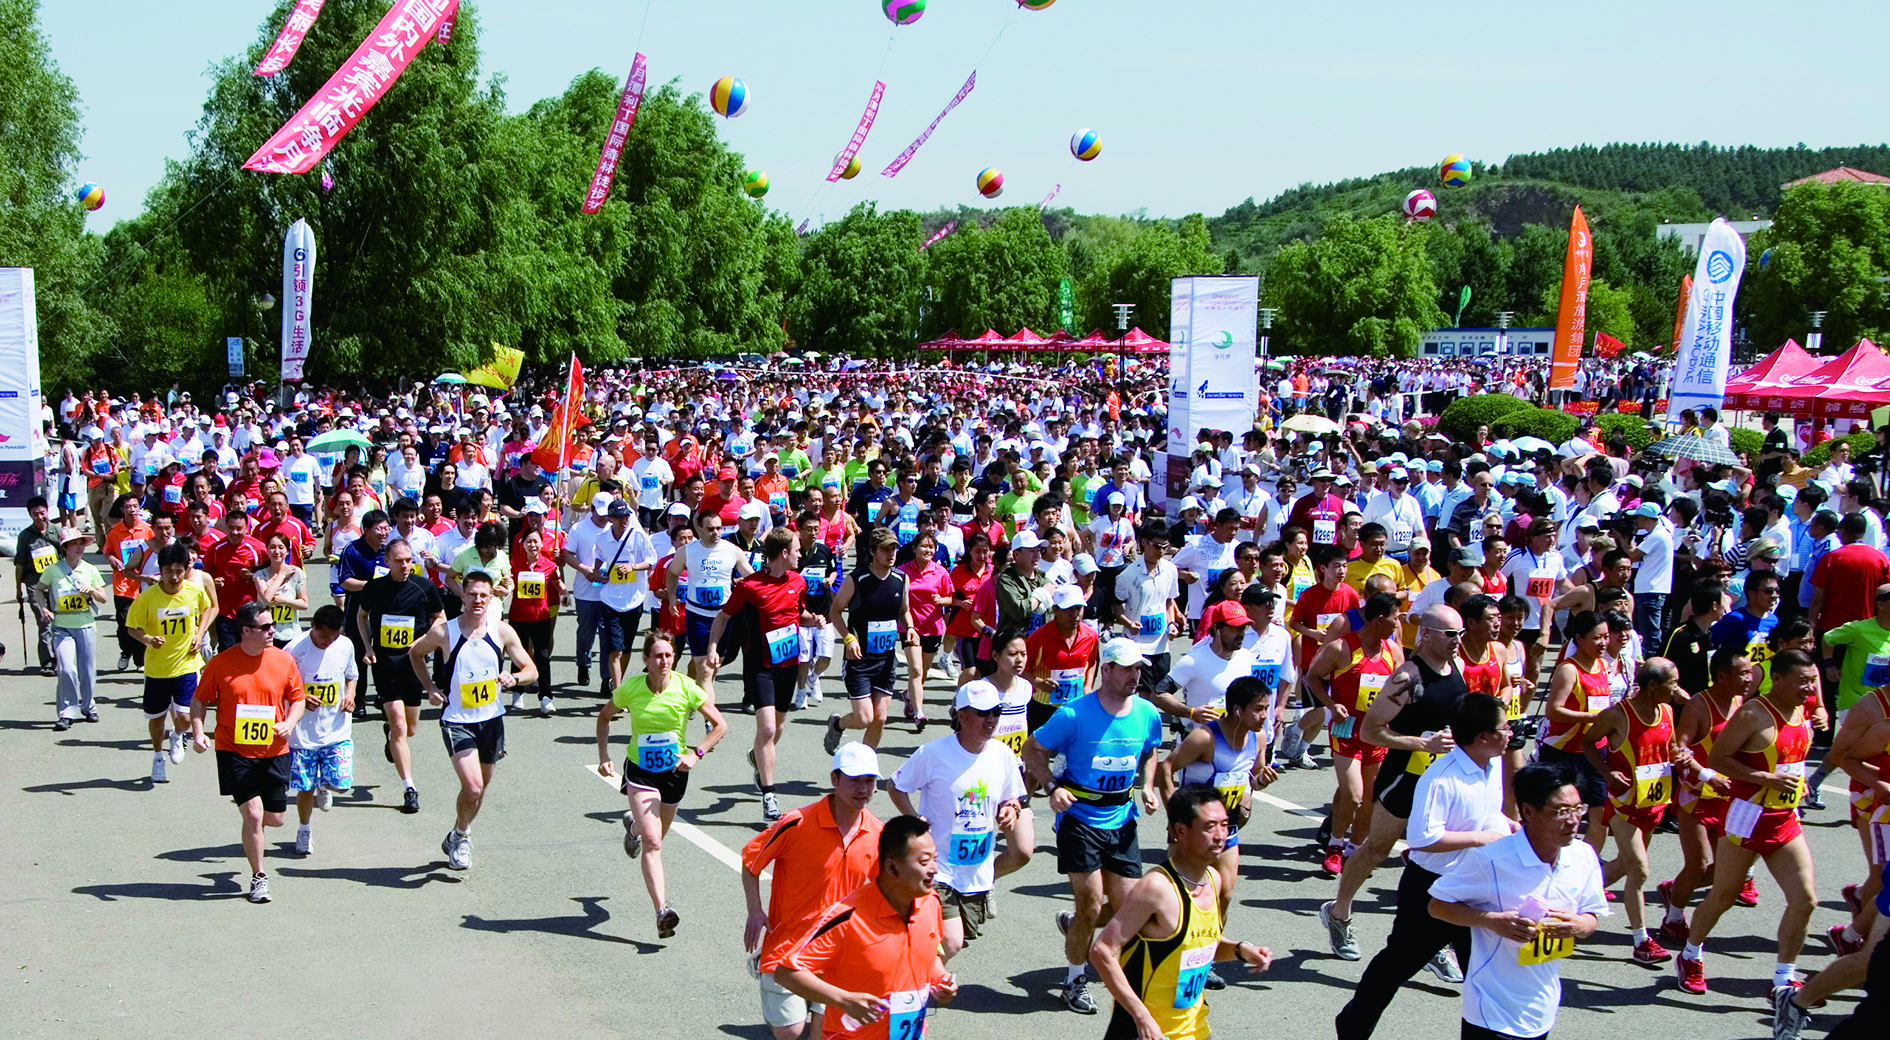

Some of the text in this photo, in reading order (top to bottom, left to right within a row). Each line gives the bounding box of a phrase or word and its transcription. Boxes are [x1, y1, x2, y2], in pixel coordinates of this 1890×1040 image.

[291, 264, 306, 353] 引领3G生活
[1697, 290, 1725, 385] 中国移动通信
[1314, 529, 1335, 540] 12967
[38, 556, 54, 570] 141
[522, 583, 541, 596] 145
[1531, 581, 1550, 594] 611
[63, 597, 83, 610] 142
[700, 590, 720, 603] 104
[161, 618, 186, 635] 171
[1145, 617, 1163, 632] 108
[386, 628, 408, 646] 148
[872, 635, 892, 650] 105
[775, 639, 795, 659] 107
[1751, 647, 1766, 662] 25
[307, 684, 336, 704] 170
[471, 684, 489, 704] 14
[1055, 684, 1078, 700] 571
[242, 722, 268, 741] 150
[645, 749, 674, 769] 553
[1096, 775, 1126, 792] 103
[1647, 782, 1663, 802] 48
[958, 839, 987, 861] 574
